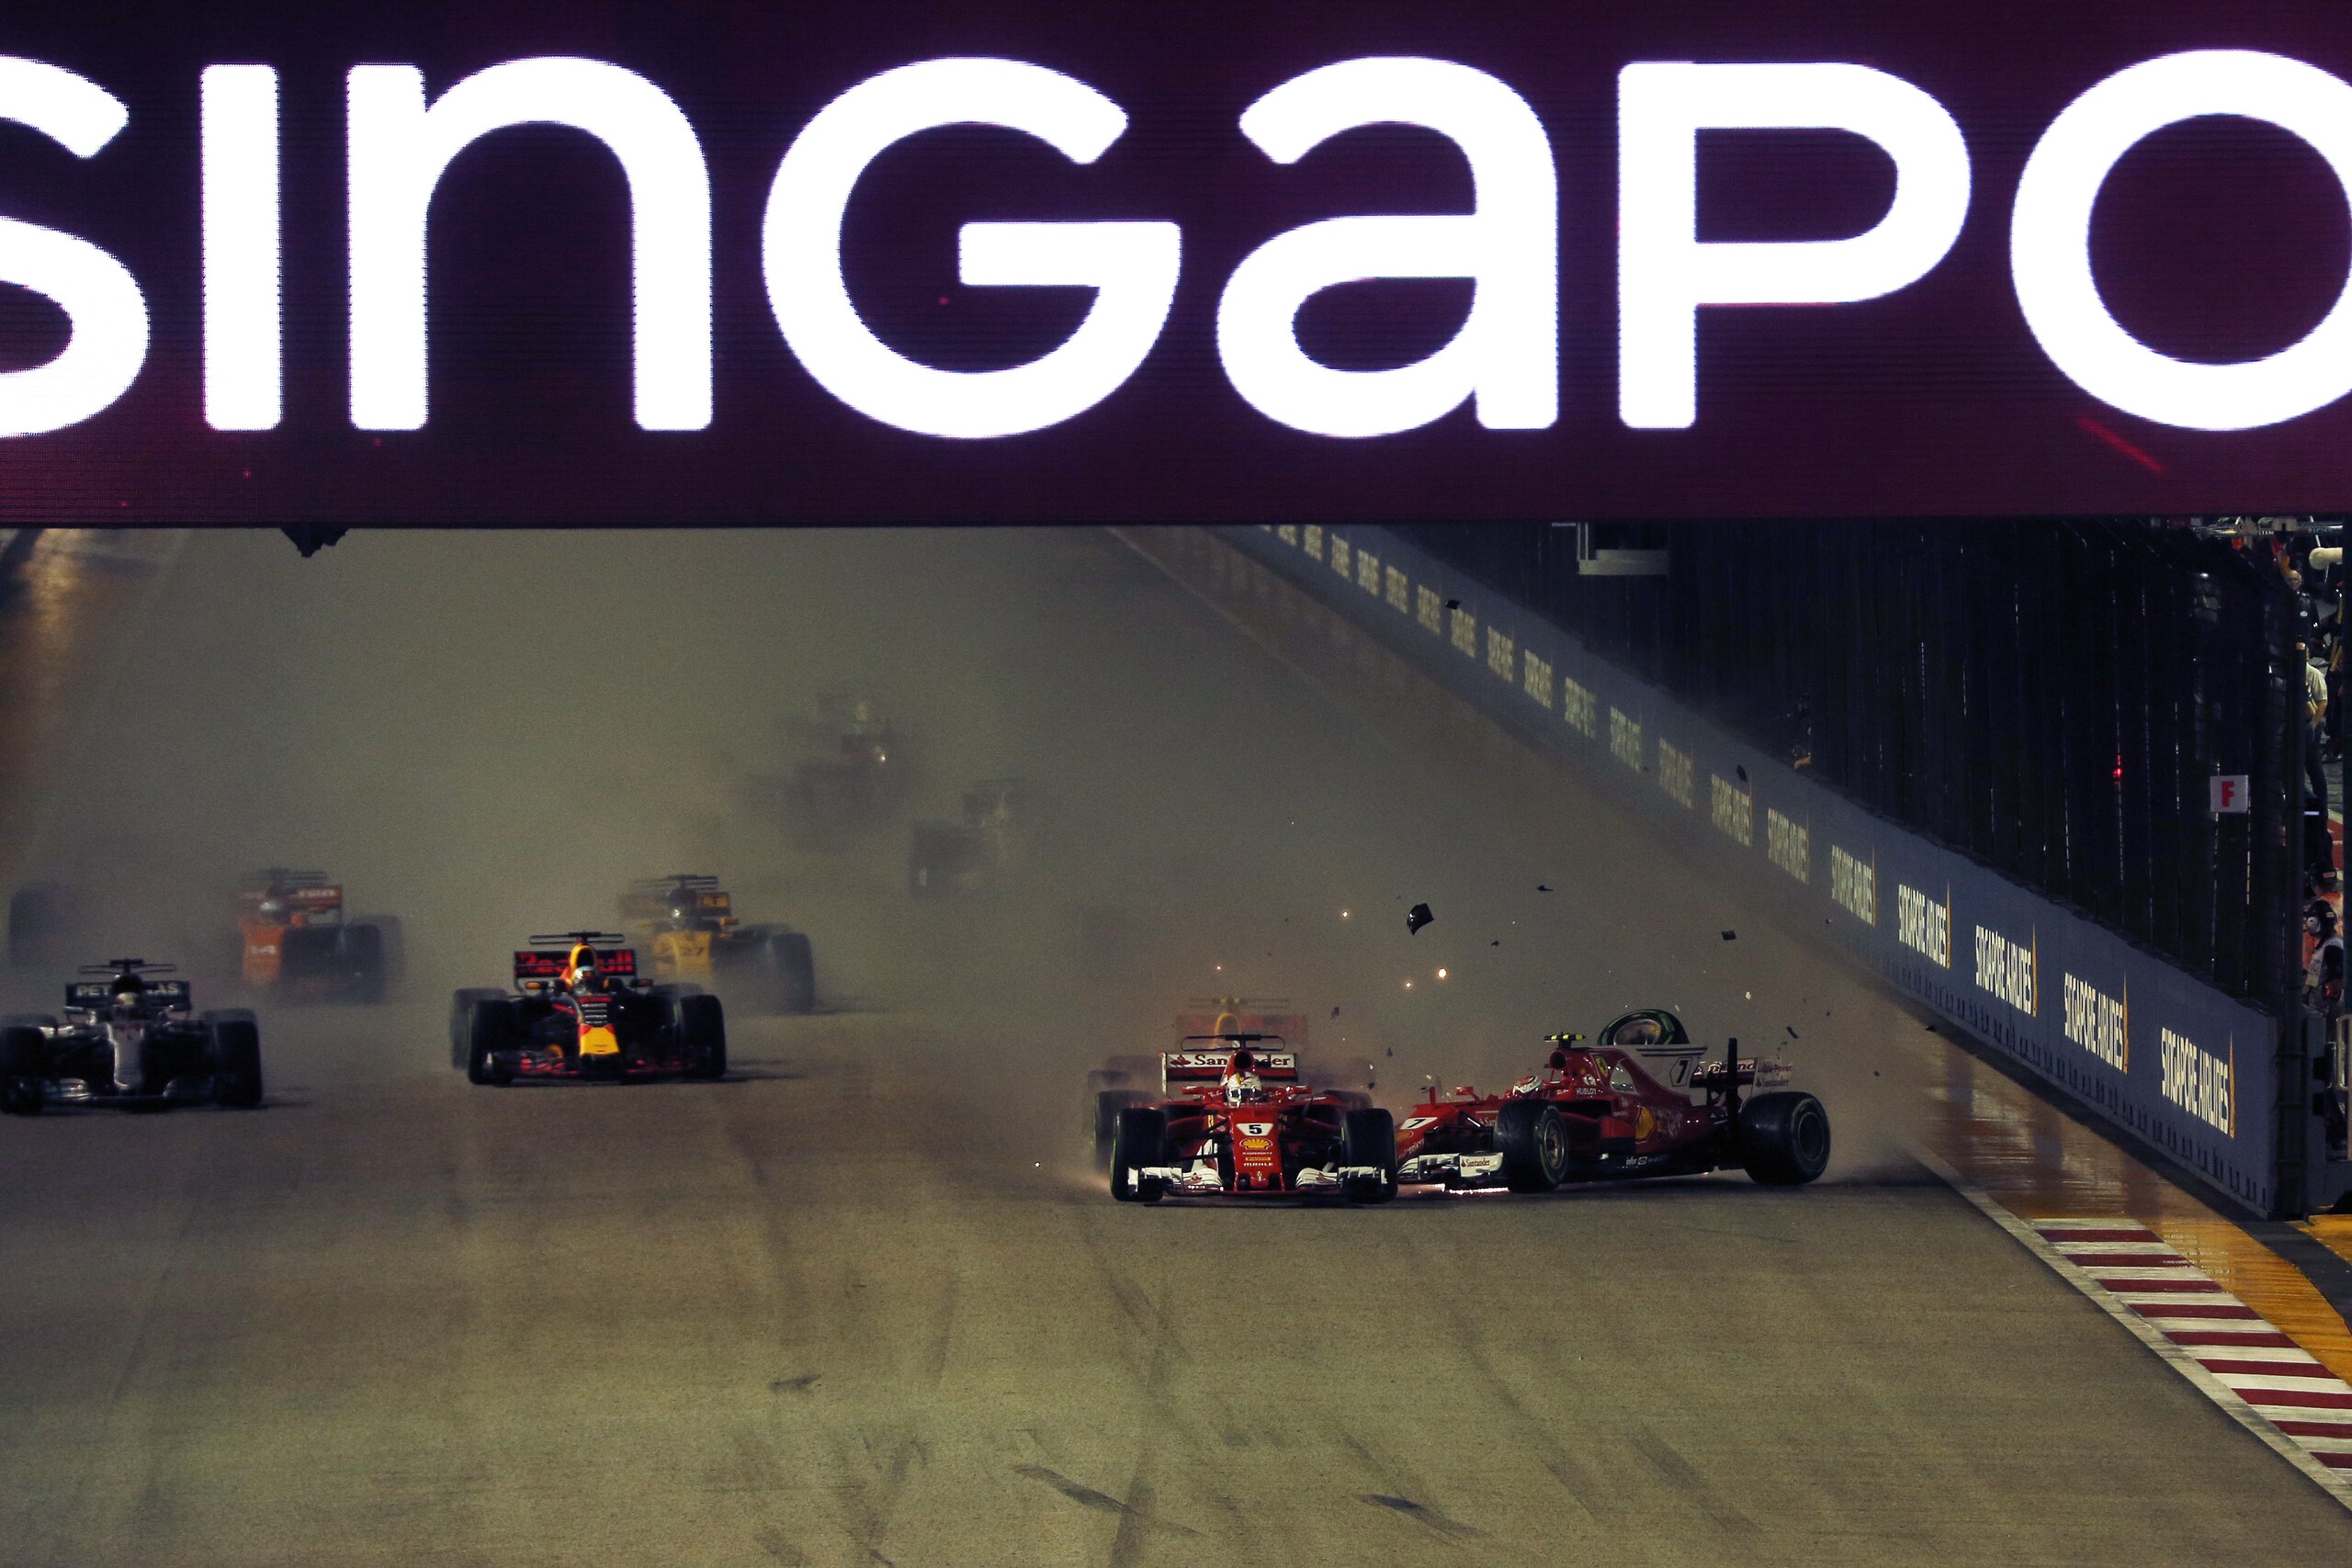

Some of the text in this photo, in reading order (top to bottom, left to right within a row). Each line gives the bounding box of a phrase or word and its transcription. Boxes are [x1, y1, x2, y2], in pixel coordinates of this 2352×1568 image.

[2222, 781, 2235, 807] F
[599, 950, 633, 972] ull
[1678, 1060, 1689, 1084] 7
[1249, 1124, 1262, 1134] 5
[1407, 1118, 1427, 1128] 7
